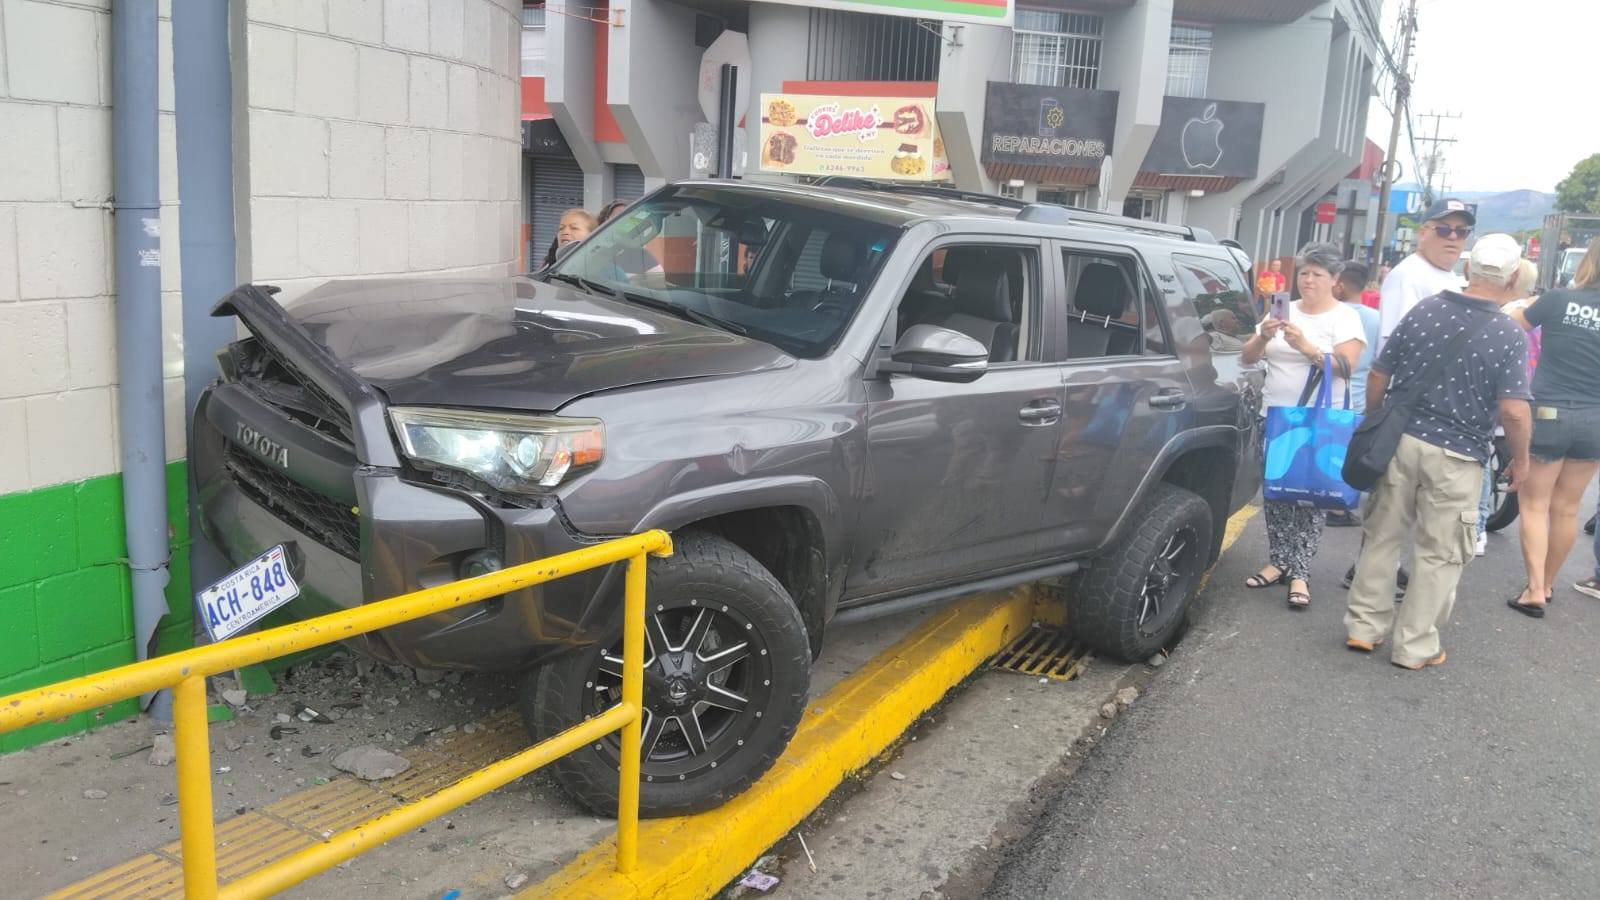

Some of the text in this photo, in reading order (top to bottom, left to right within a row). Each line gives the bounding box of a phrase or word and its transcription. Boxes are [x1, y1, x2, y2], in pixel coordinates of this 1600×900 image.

[813, 109, 876, 137] Delike
[992, 135, 1105, 157] REPARACIONES
[1562, 315, 1590, 325] AUTO
[236, 421, 288, 468] TOYOTA
[221, 564, 261, 591] COSTA RICA
[207, 561, 286, 629] ACH-848
[225, 594, 281, 631] CENTROAMERICA
